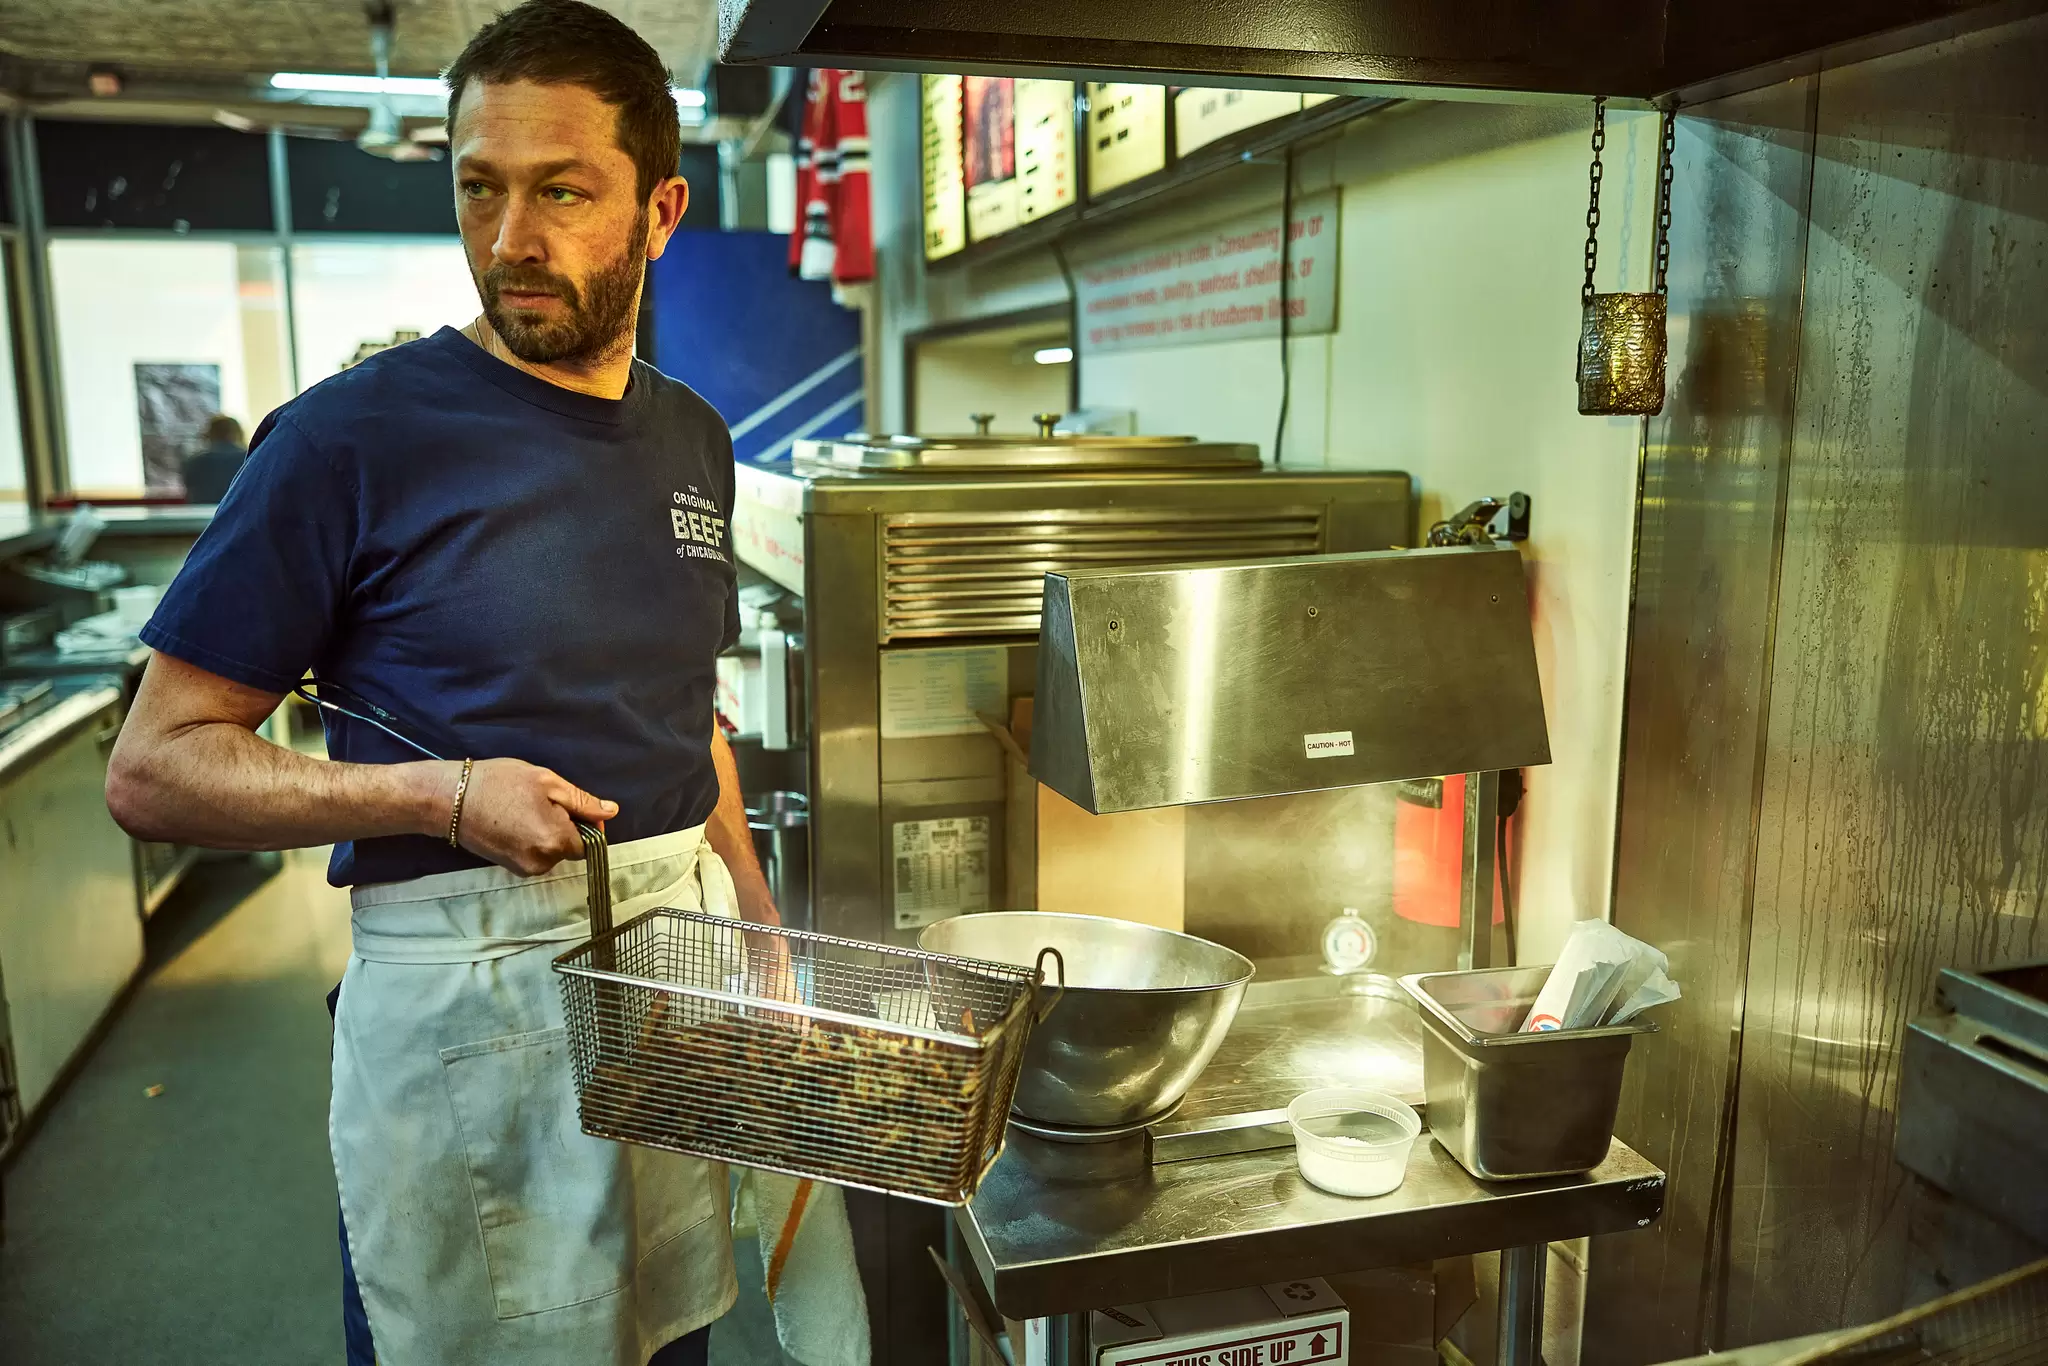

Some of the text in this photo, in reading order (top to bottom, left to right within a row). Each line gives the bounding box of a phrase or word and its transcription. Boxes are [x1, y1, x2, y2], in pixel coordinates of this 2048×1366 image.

[687, 484, 699, 494] THE
[673, 491, 718, 513] ORIGINAL
[670, 508, 725, 548] BEEF
[676, 543, 686, 558] of
[1218, 1345, 1264, 1366] SIDE
[1270, 1340, 1296, 1364] UP
